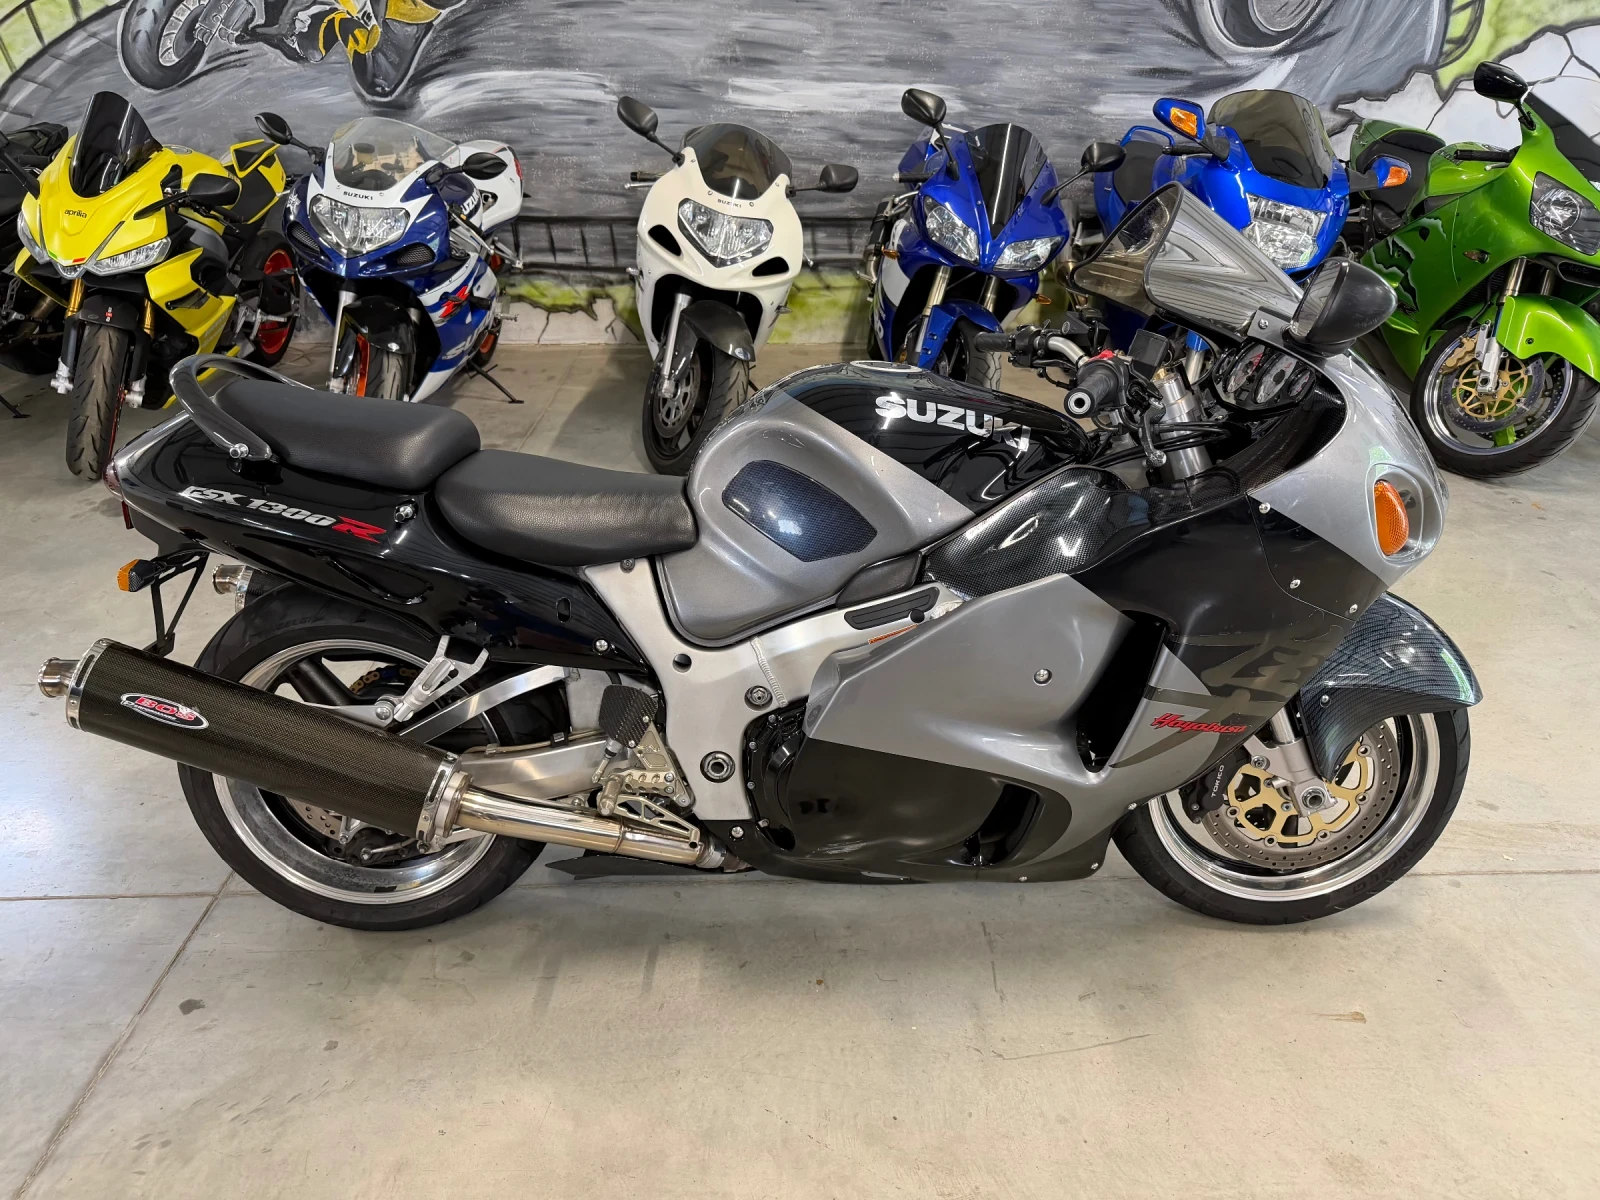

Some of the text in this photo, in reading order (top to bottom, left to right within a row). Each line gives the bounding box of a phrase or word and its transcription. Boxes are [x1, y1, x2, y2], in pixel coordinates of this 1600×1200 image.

[343, 191, 373, 201] SUZUKI
[64, 209, 88, 218] aprilia
[875, 393, 1031, 452] SUZUKI
[135, 697, 197, 721] BOS
[1150, 712, 1248, 733] Hayabusa
[1210, 764, 1225, 798] TOKICO
